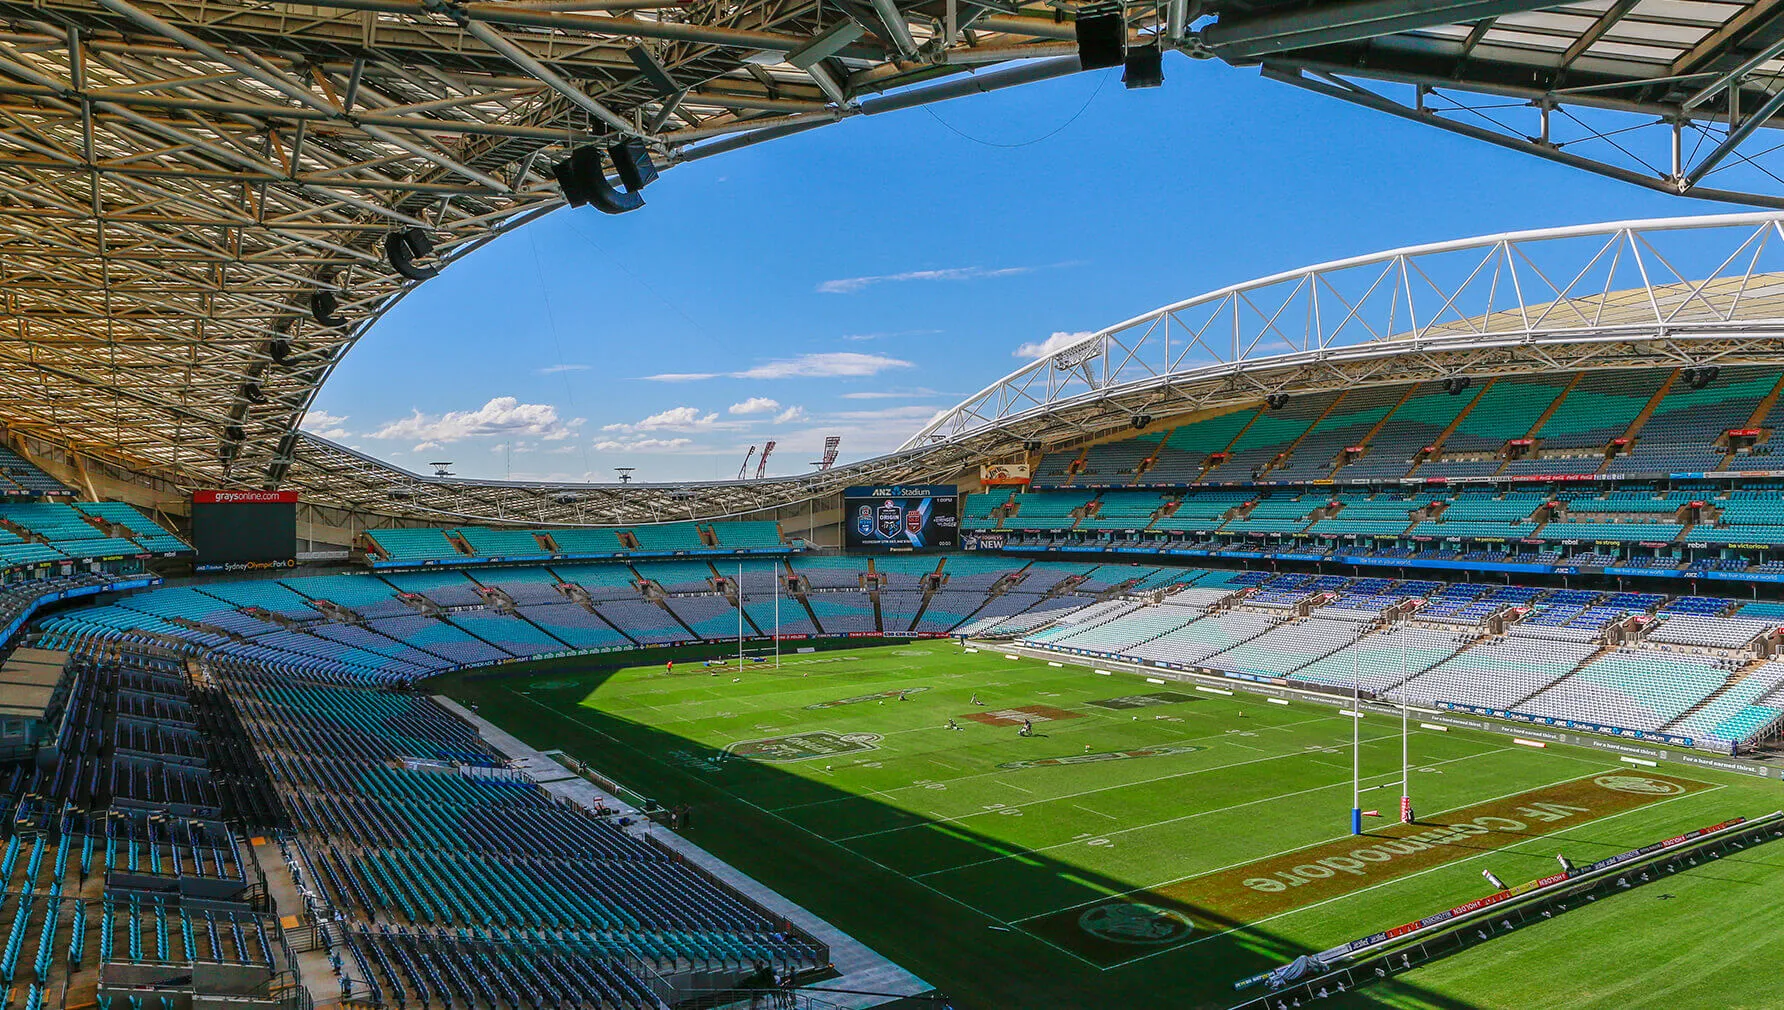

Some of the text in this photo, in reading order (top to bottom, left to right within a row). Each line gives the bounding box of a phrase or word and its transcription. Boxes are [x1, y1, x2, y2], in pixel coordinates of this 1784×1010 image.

[215, 492, 280, 502] graysonline.com
[872, 488, 931, 497] ANZ Stadium
[980, 540, 1003, 549] NEW
[1609, 743, 1620, 751] hard
[1621, 745, 1638, 753] earned
[1699, 758, 1713, 766] hard
[1713, 760, 1736, 769] earned
[1243, 802, 1590, 893] VF Commodore
[1539, 874, 1562, 887] HOLDEN
[1453, 902, 1478, 916] HOLDEN
